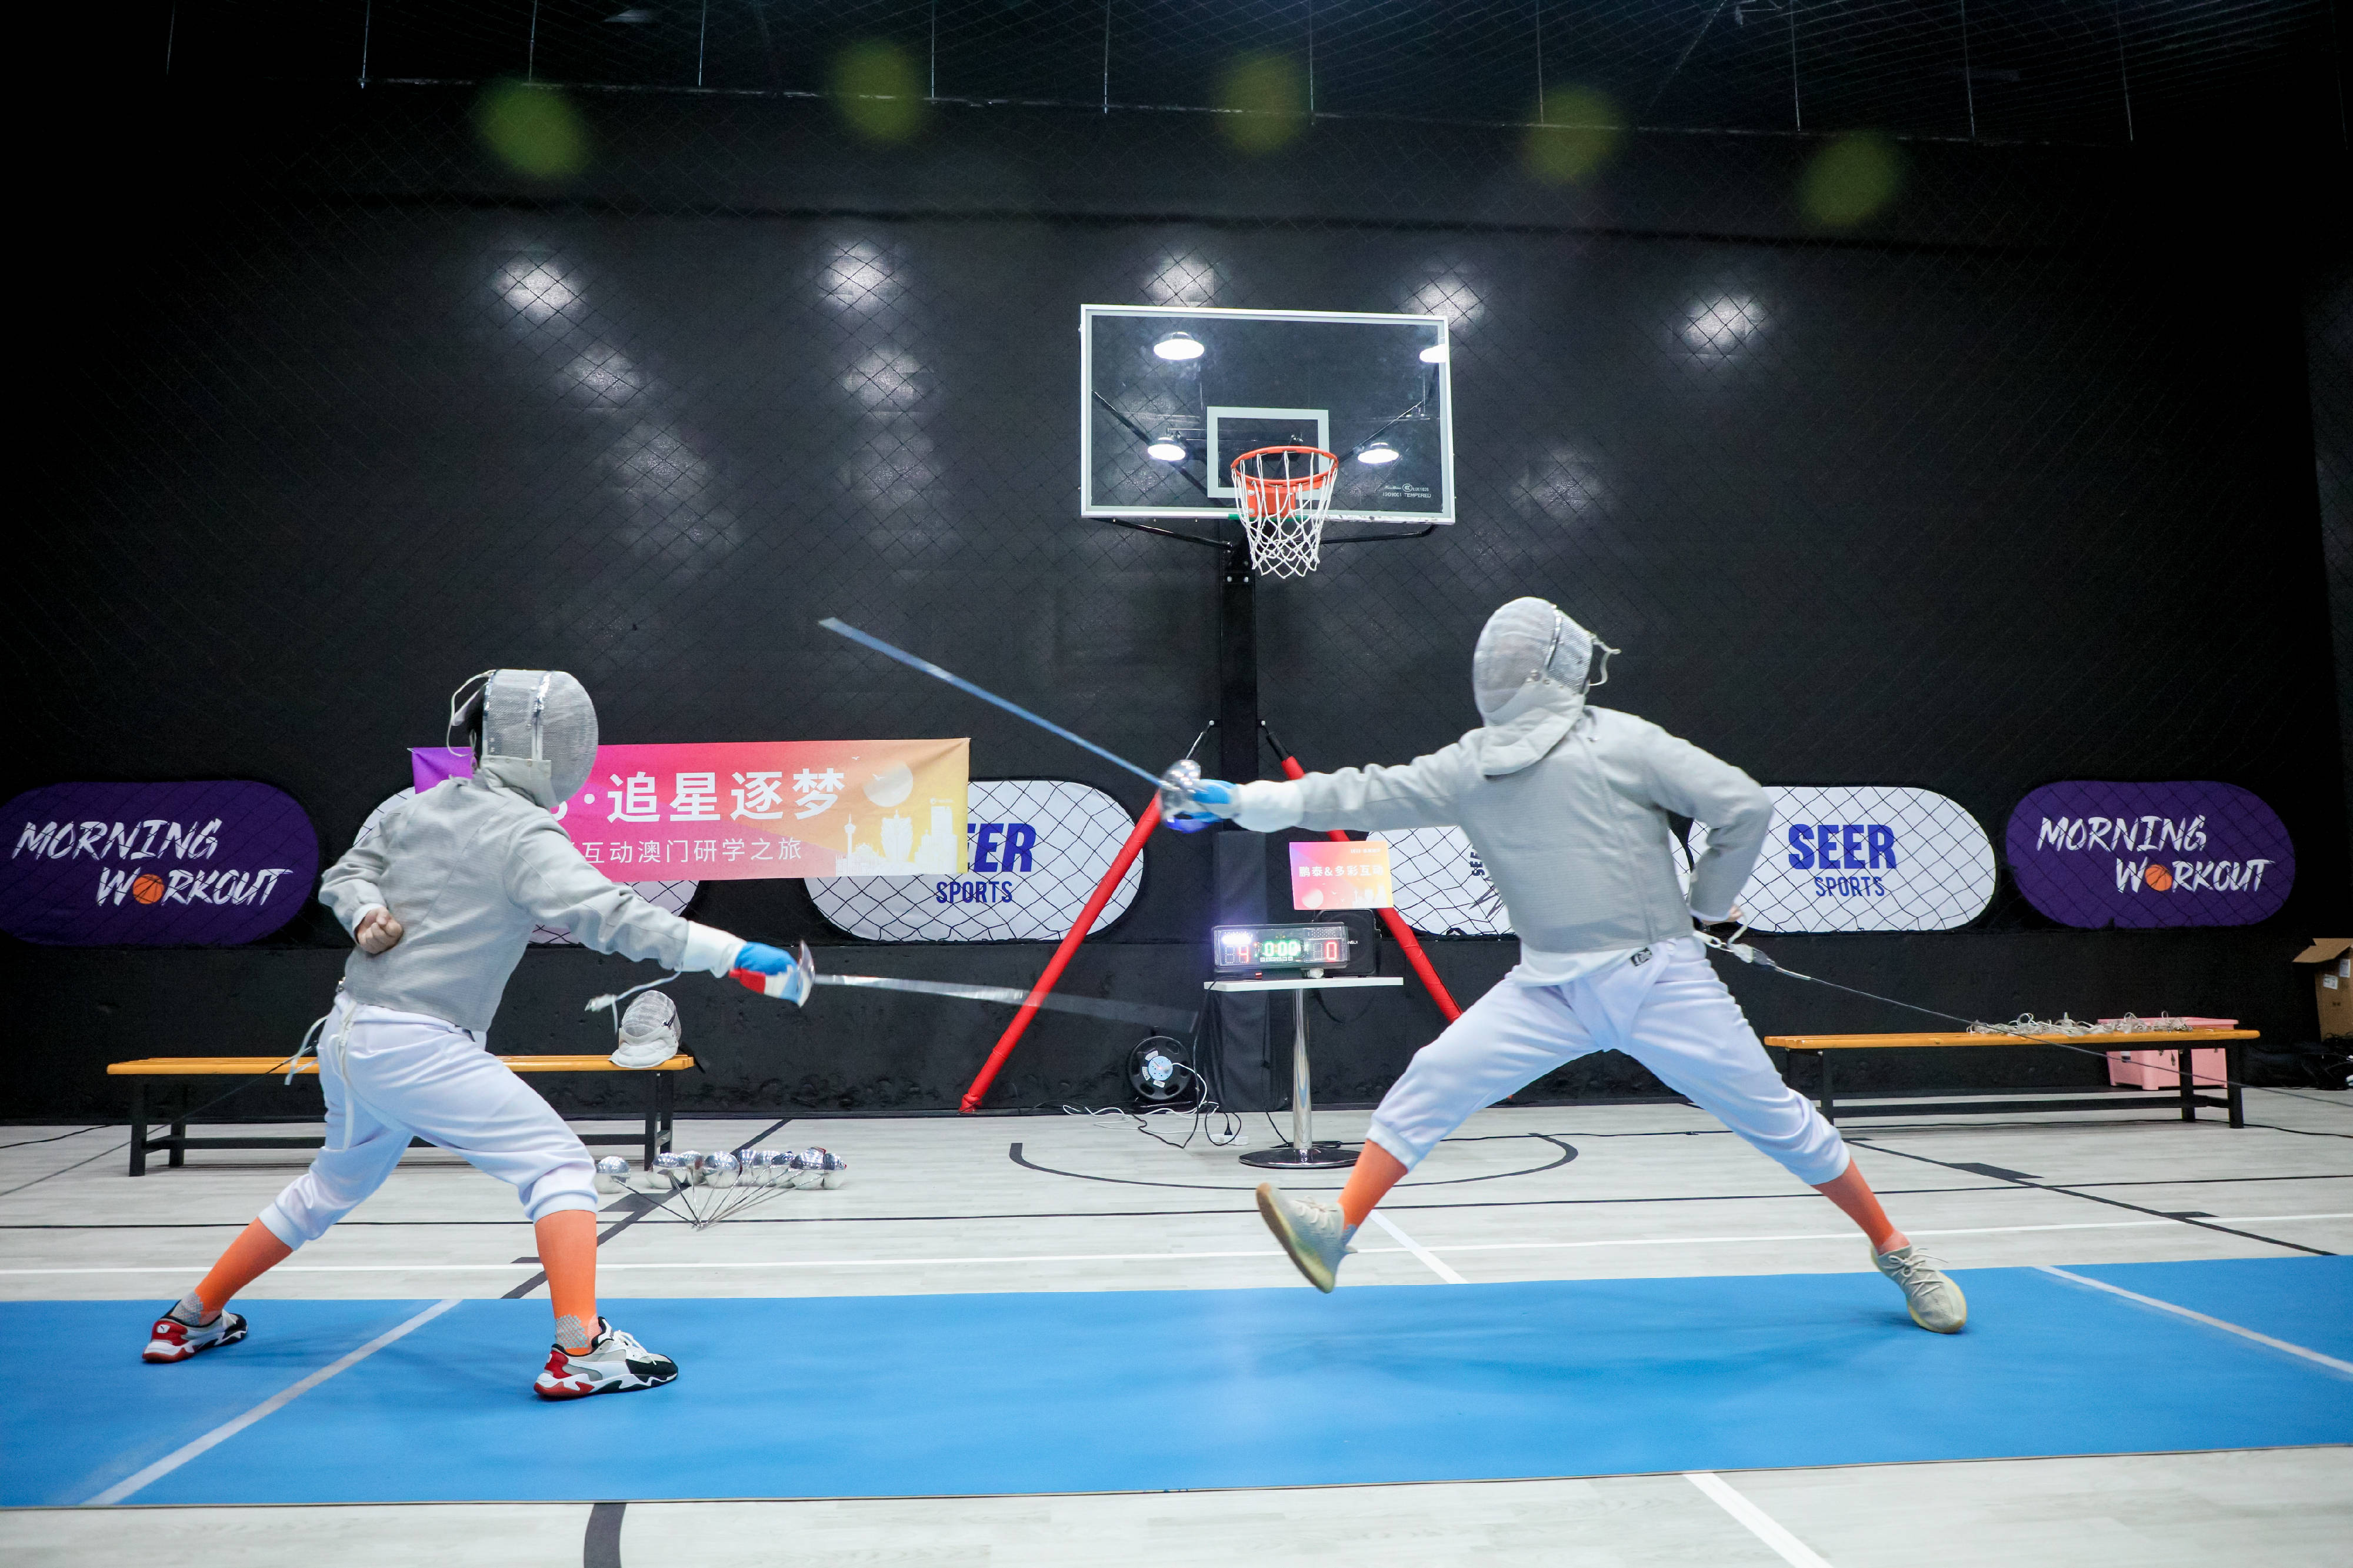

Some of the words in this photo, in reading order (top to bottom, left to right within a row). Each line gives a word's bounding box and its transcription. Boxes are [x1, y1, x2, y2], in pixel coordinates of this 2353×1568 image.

[551, 768, 845, 823] ·追星逐梦
[12, 818, 222, 860] MORNING
[1788, 824, 1897, 870] SEER
[2037, 815, 2207, 852] MORNING
[572, 837, 802, 864] 互动澳门研学之旅
[1299, 865, 1384, 877] 鹏泰&多彩互动
[936, 881, 1013, 903] SPORTS
[1814, 876, 1884, 897] SPORTS
[1326, 941, 1337, 960] 0
